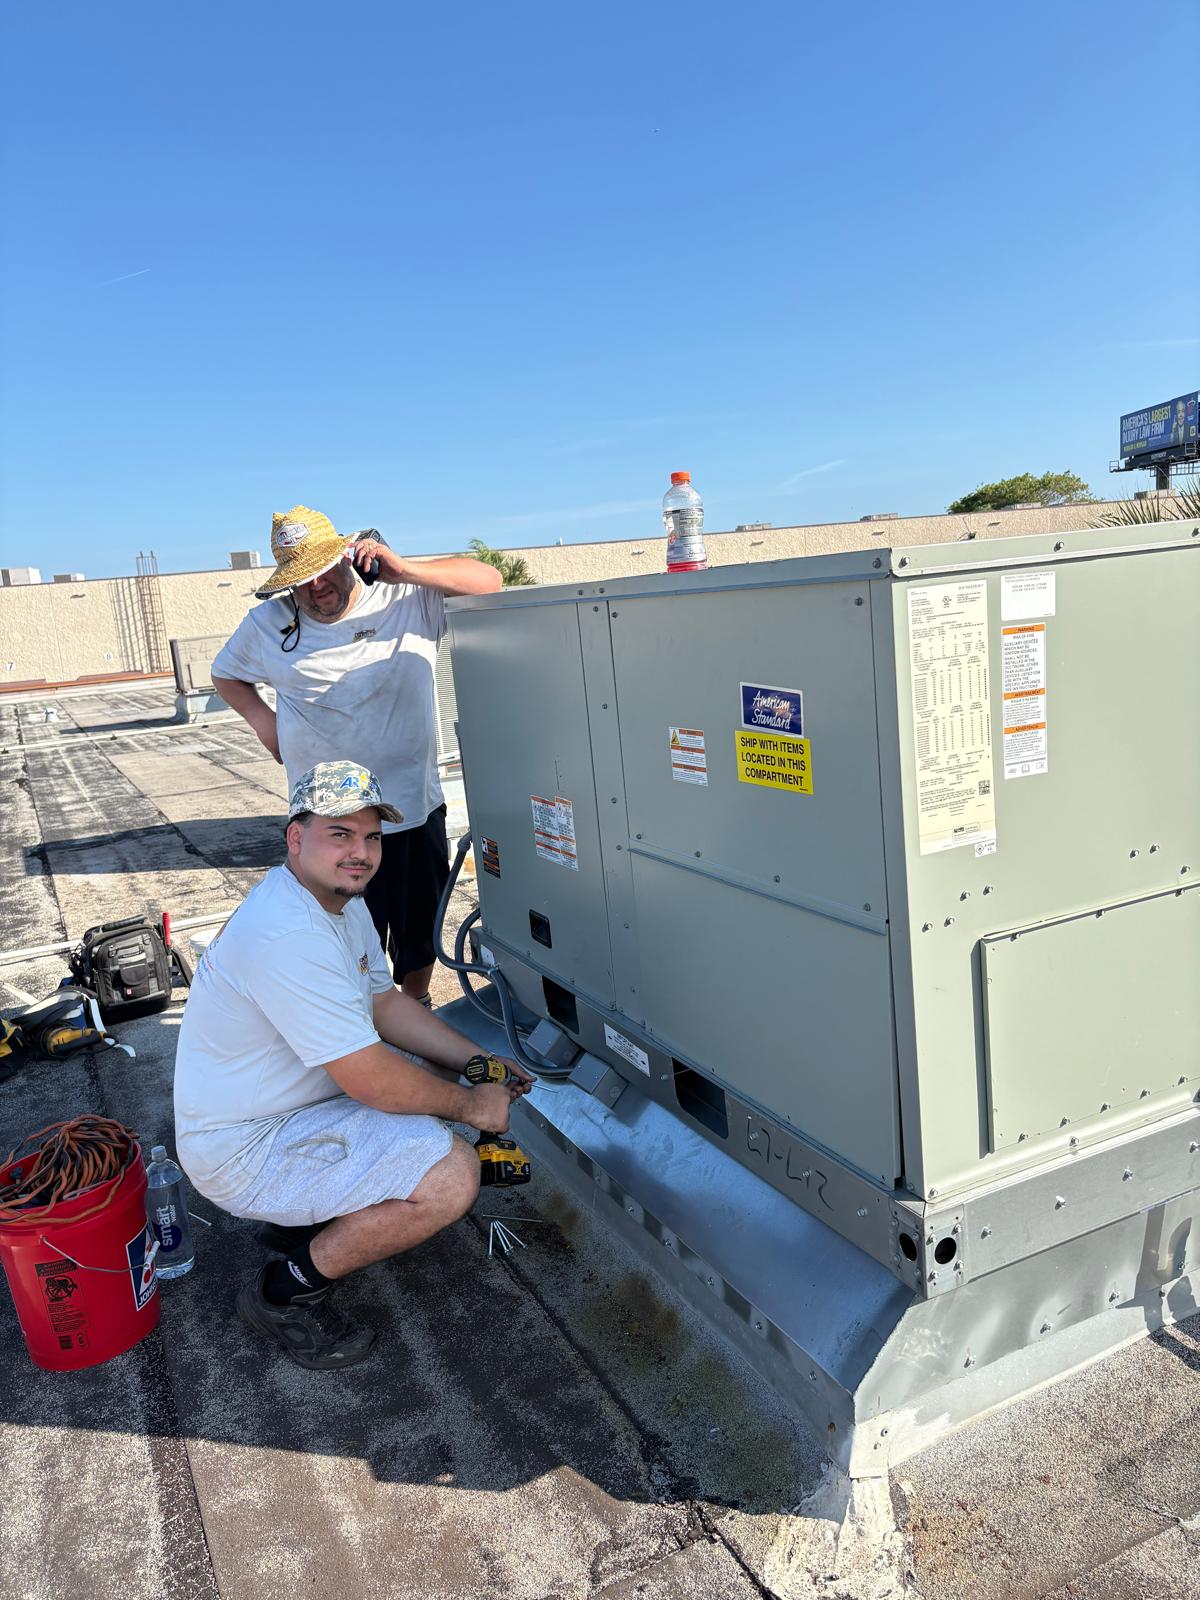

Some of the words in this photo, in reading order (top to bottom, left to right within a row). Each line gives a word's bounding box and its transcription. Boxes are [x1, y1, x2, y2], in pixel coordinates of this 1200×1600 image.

[1122, 412, 1148, 431] AMERICA'S
[1148, 406, 1171, 424] LARGEST
[1122, 430, 1139, 444] INJURY
[1139, 426, 1150, 438] LAW
[1151, 422, 1165, 436] FIRM
[8, 662, 14, 670] 7
[752, 690, 790, 712] American
[752, 708, 792, 730] Standard
[740, 736, 757, 748] SHIP
[758, 739, 778, 751] WITH
[780, 742, 805, 755] ITEMS
[741, 752, 776, 766] LOCATED
[778, 756, 785, 768] IN
[787, 758, 806, 771] THIS
[745, 767, 804, 786] COMPARTMENT
[156, 1206, 173, 1246] smart
